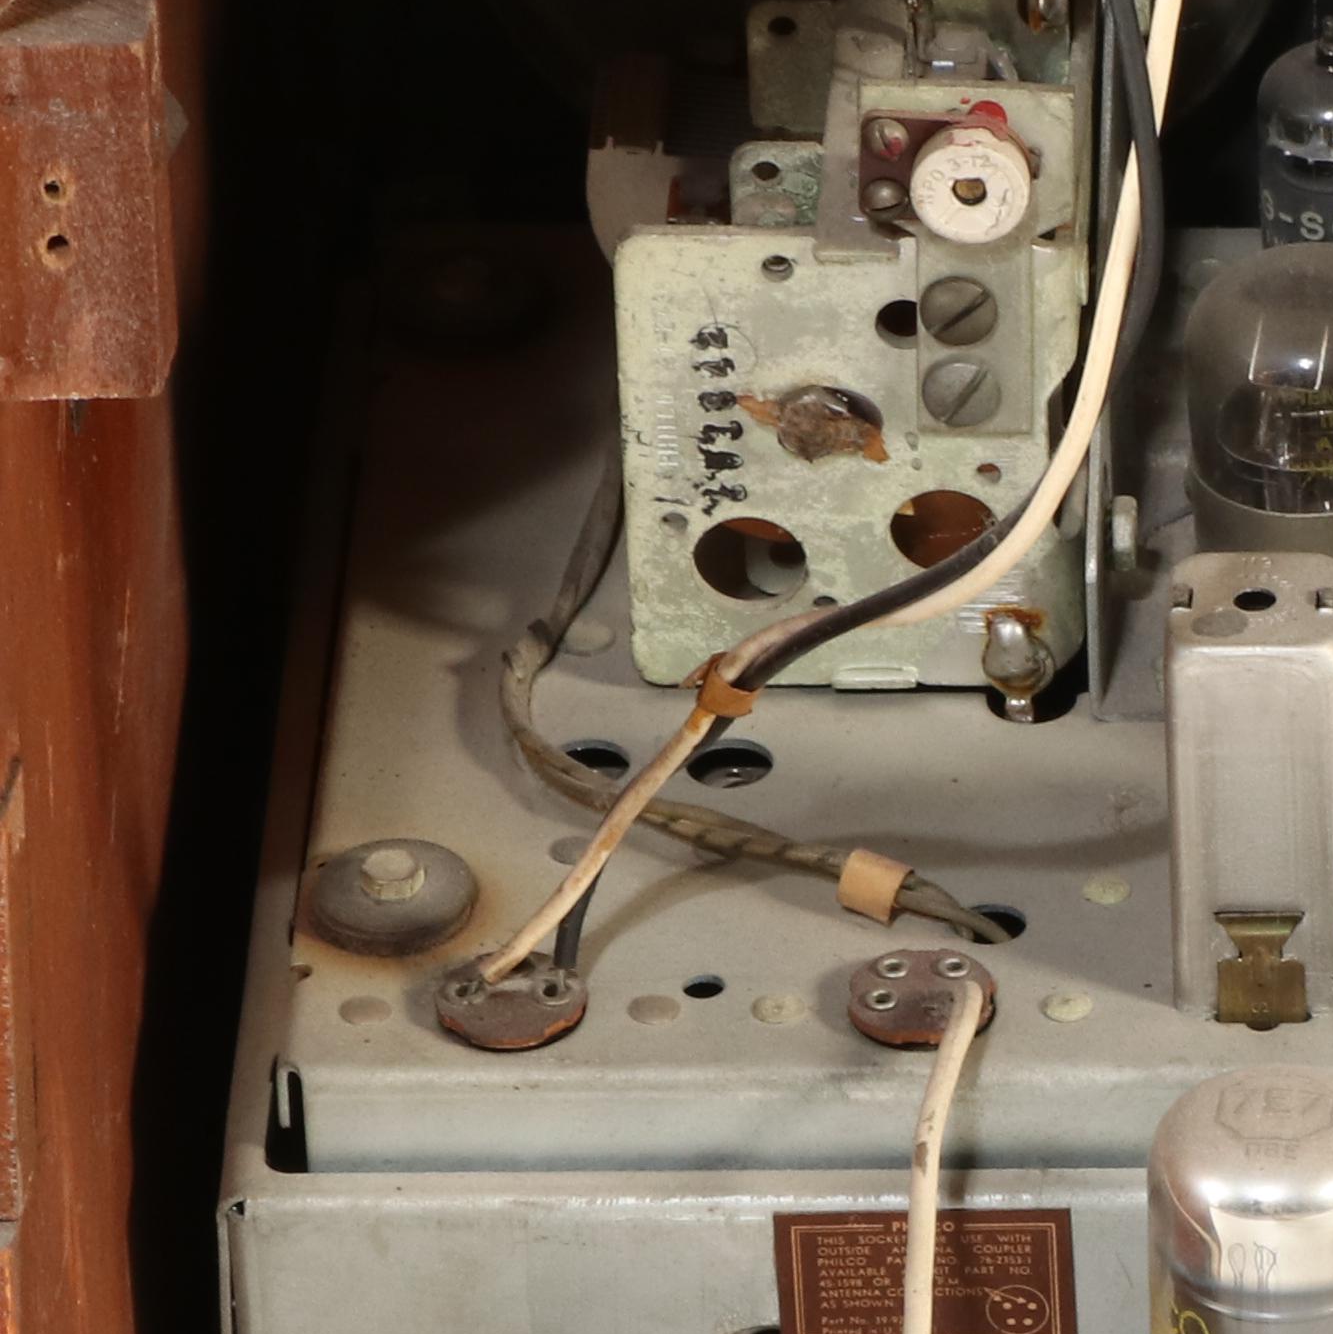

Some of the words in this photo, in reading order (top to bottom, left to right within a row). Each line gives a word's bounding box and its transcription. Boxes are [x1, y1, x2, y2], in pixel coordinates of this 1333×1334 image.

[817, 1235, 846, 1245] THIS
[996, 1233, 1032, 1243] WITH
[818, 1246, 871, 1256] OUTSIDE
[973, 1244, 1032, 1254] COUPLER
[817, 1257, 867, 1267] PHILCO
[820, 1266, 887, 1277] AVAILABLE
[964, 1266, 995, 1275] PART
[872, 1276, 891, 1287] OR
[820, 1288, 882, 1298] ANTENNA
[820, 1301, 837, 1309] AS
[843, 1299, 895, 1309] SHOWN
[821, 1316, 844, 1325] Part
